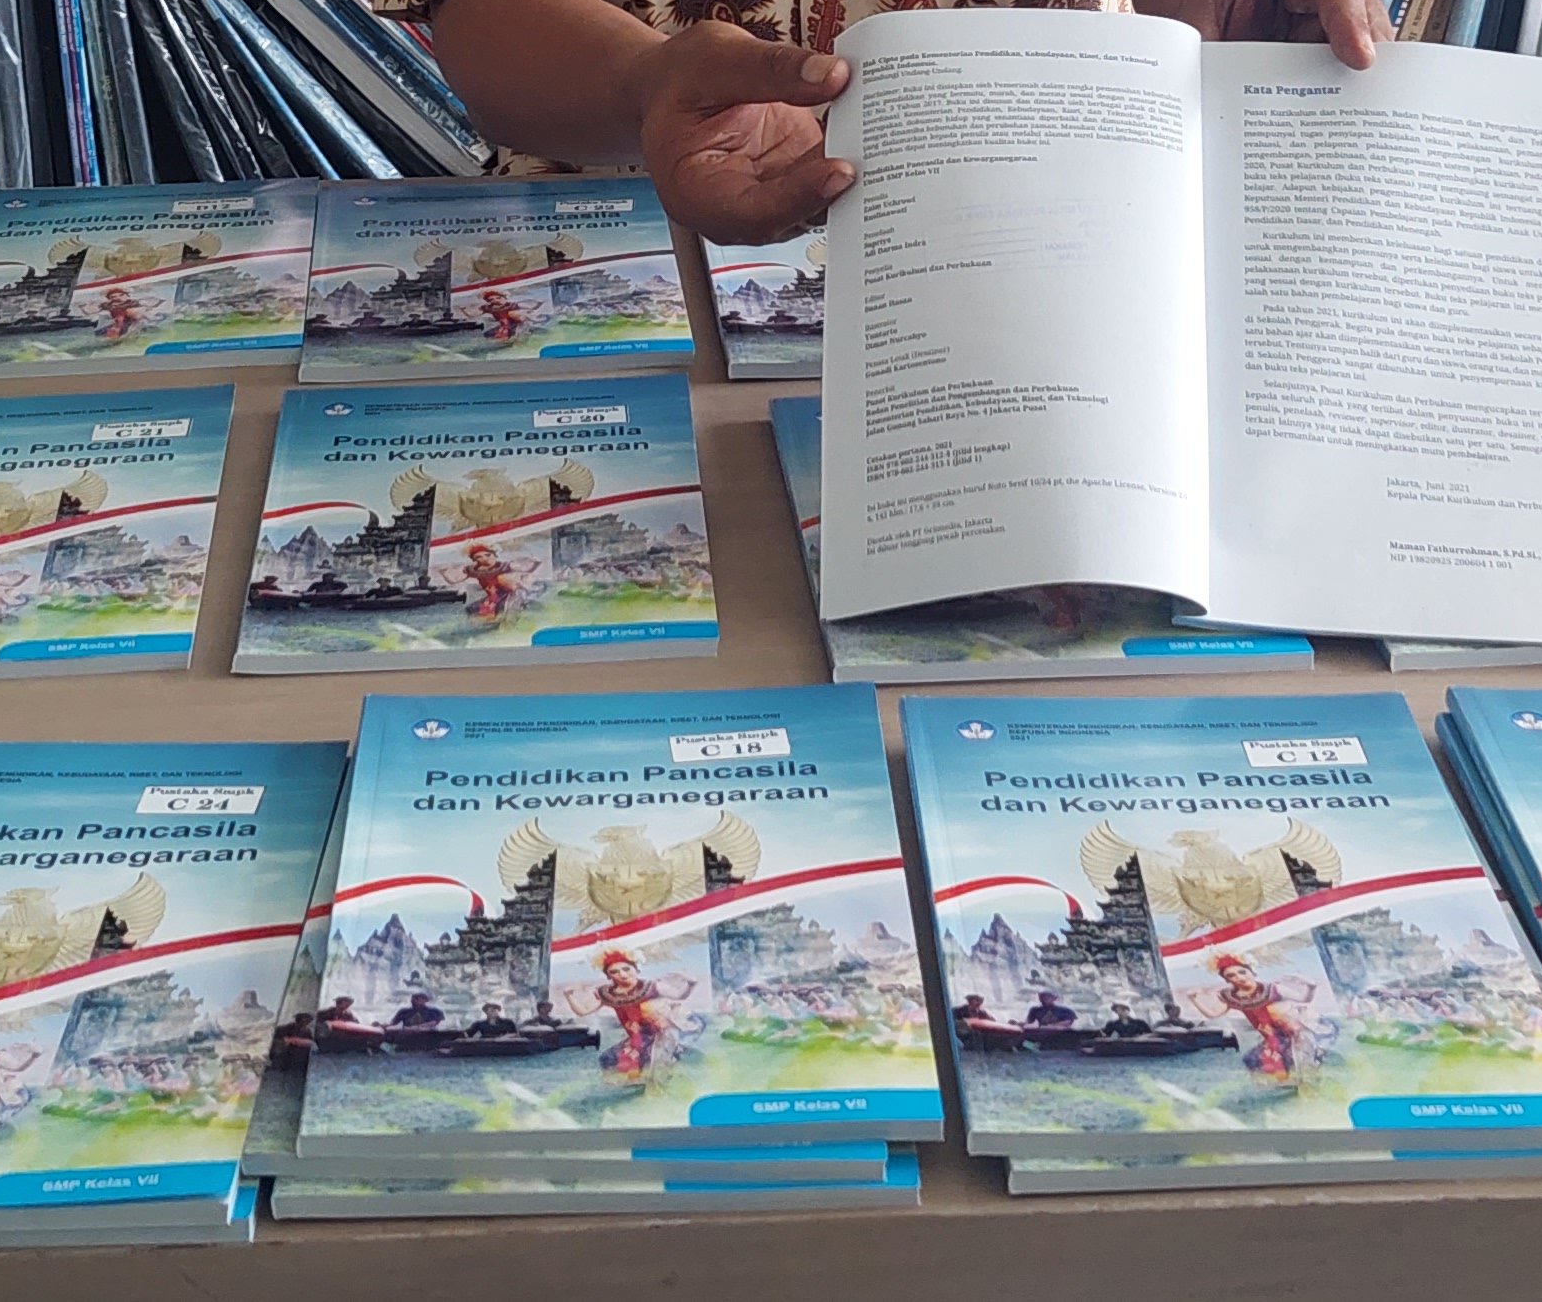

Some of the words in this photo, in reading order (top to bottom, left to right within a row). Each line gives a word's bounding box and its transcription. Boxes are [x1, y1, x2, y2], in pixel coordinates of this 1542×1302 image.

[1243, 85, 1272, 95] Kata
[1275, 85, 1341, 97] Pengantar
[30, 436, 172, 455] Pancasila
[333, 429, 498, 447] Pendidikan
[505, 424, 642, 442] Pancasila
[323, 448, 380, 463] dan
[387, 441, 649, 463] Kewarganegaraan
[1389, 541, 1426, 551] Maman
[426, 766, 629, 788] Pendidikan
[644, 760, 819, 782] Pancasila
[984, 770, 1185, 792] Pendidikan
[1197, 768, 1373, 788] Pancasila
[413, 793, 481, 812] dan
[495, 785, 829, 810] Kewarganegaraan
[980, 794, 1048, 814] dan
[1060, 792, 1390, 814] Kewarganegaraan
[77, 821, 257, 840] Pancasila
